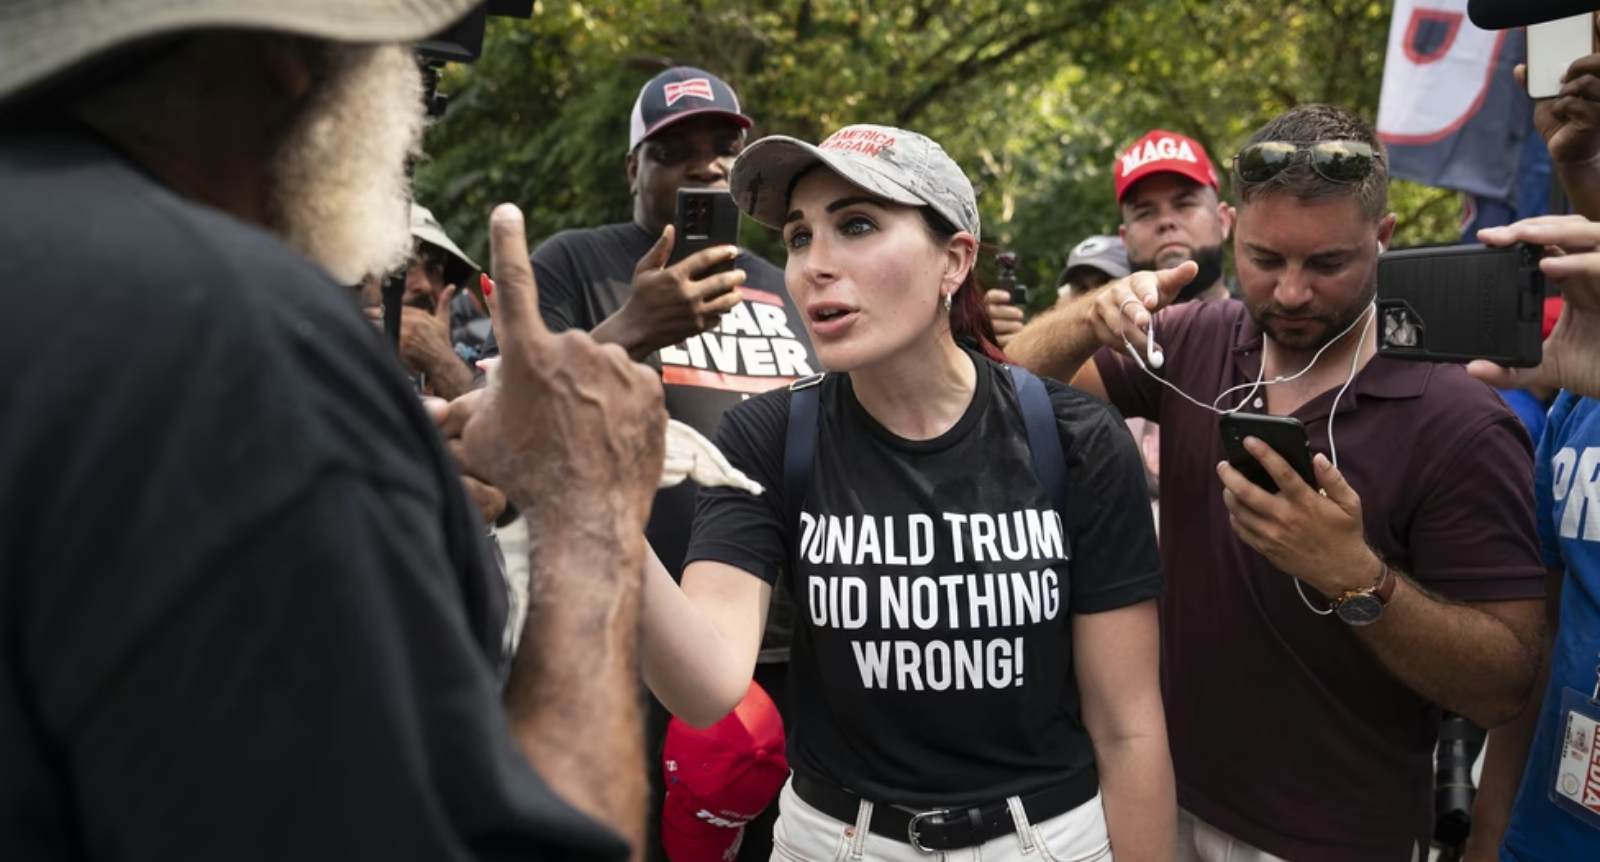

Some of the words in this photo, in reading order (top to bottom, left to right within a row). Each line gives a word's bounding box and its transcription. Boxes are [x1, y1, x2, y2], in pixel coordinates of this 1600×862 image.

[831, 129, 895, 147] AMERICA
[833, 140, 881, 157] AGAIN
[1121, 137, 1197, 178] MAGA
[713, 301, 796, 338] AR
[800, 511, 934, 566] DONALD
[943, 509, 1068, 563] TRUM
[808, 575, 868, 630] DID
[880, 568, 1060, 630] NOTHING
[851, 637, 1024, 691] WRONG!
